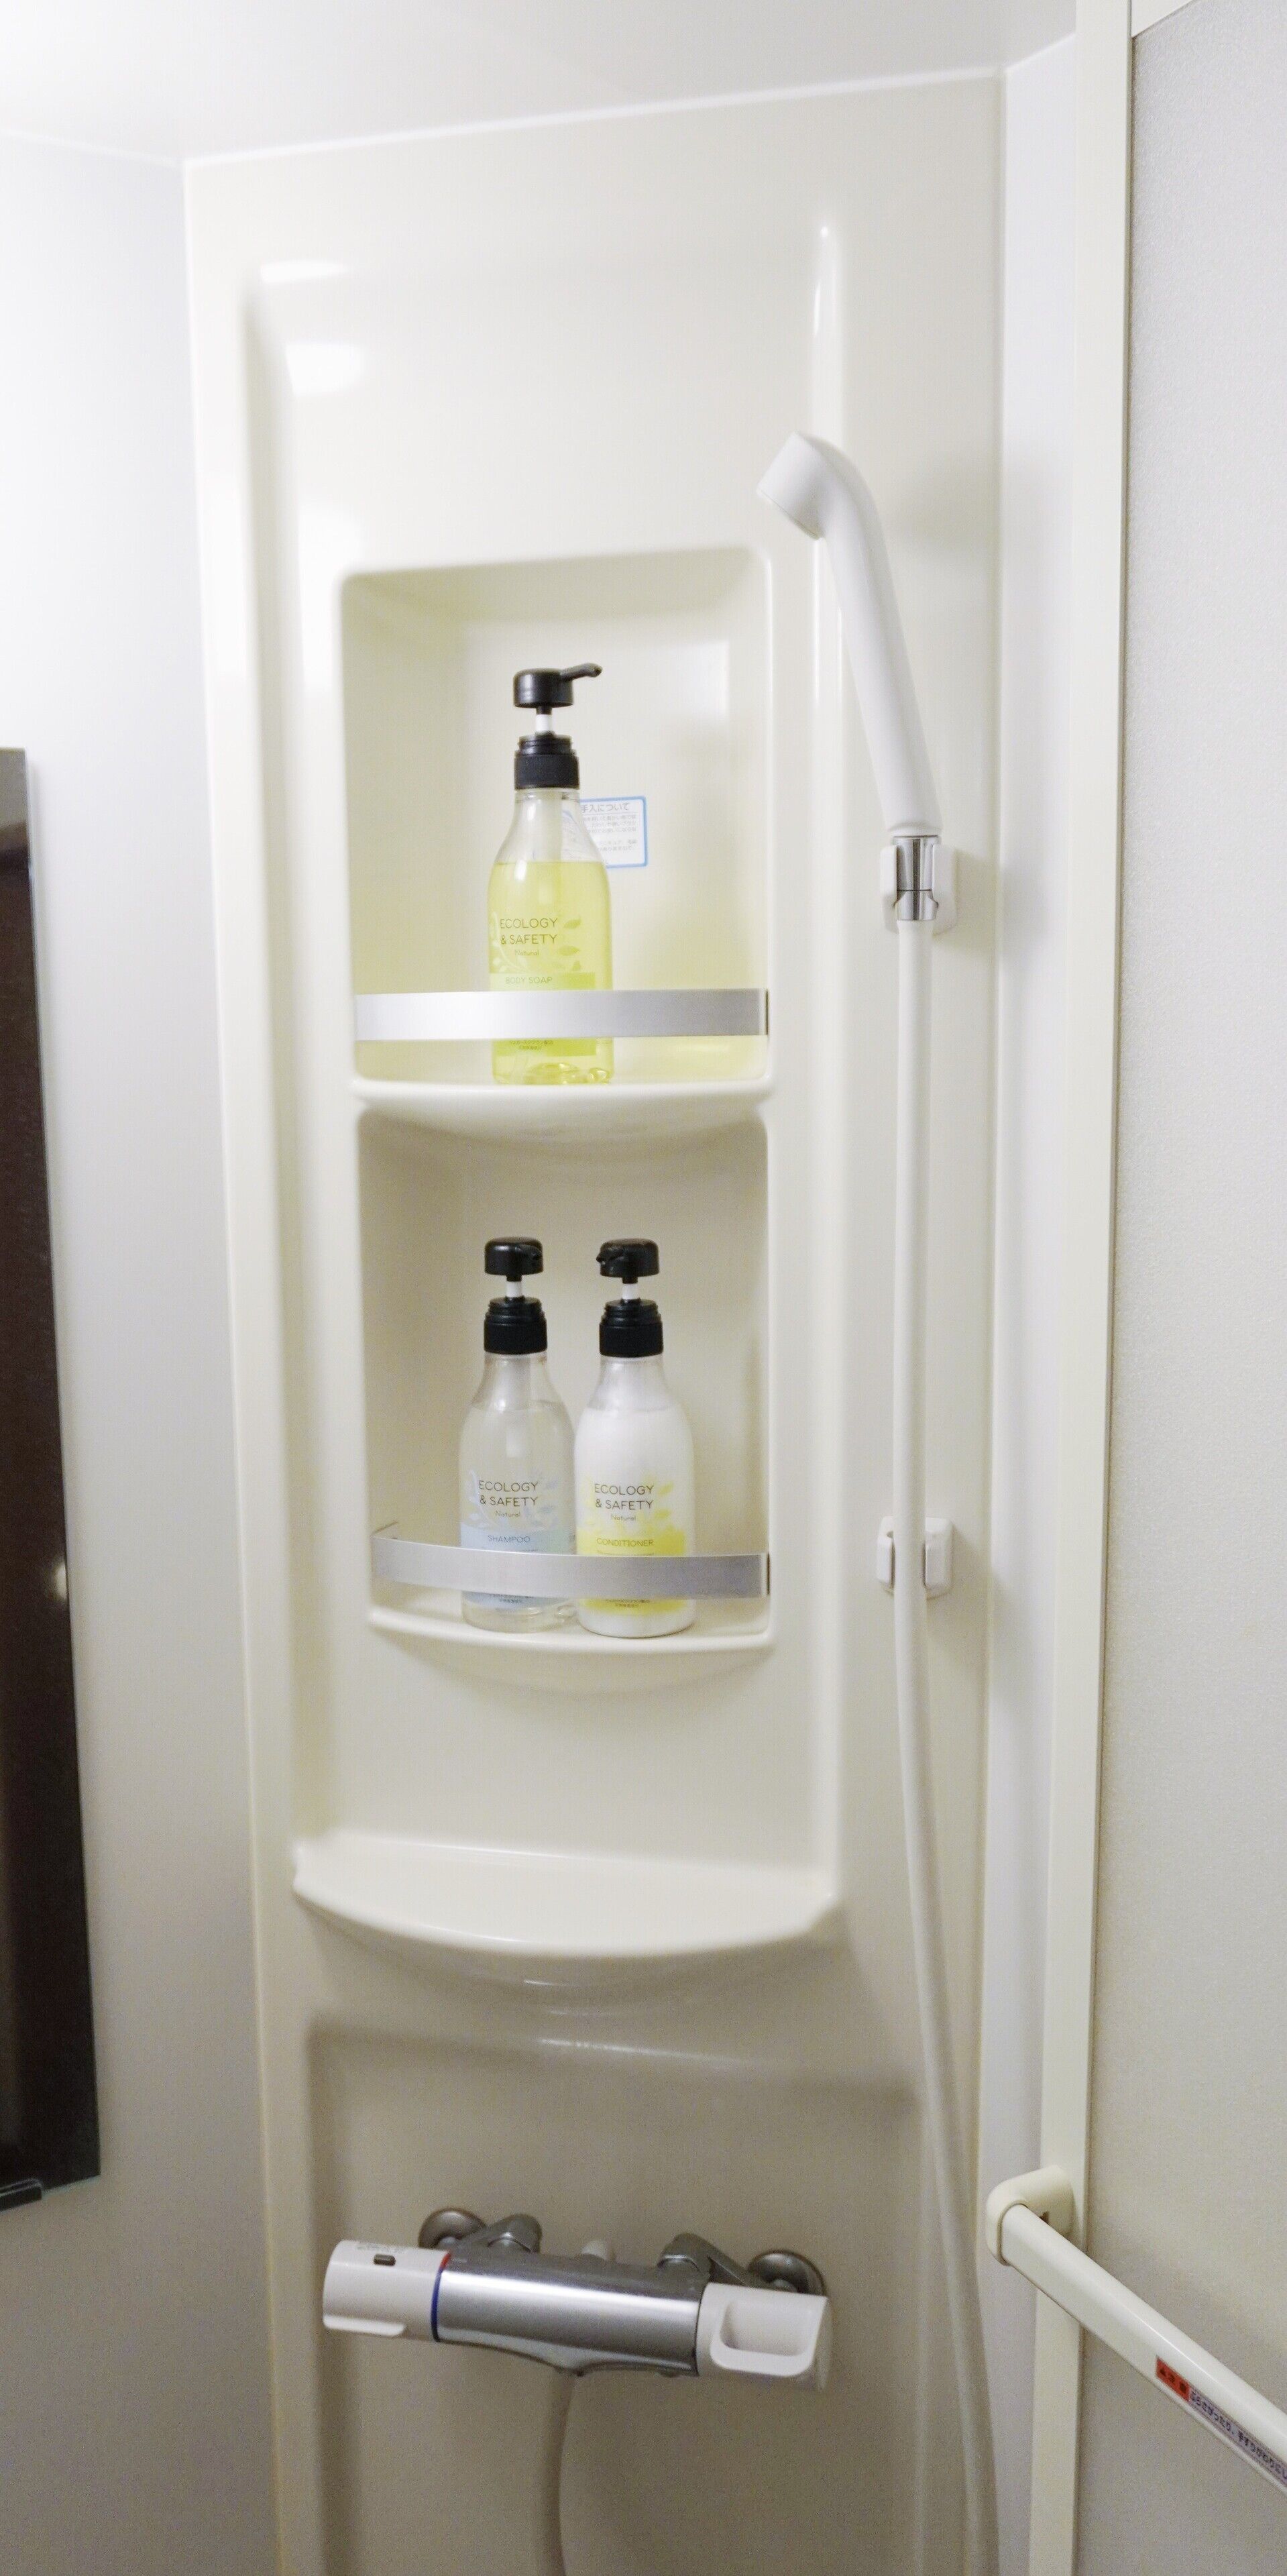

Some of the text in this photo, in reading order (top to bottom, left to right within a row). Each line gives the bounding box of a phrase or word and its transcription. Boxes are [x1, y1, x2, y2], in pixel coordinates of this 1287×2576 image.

[500, 918, 558, 929] ECOLOGY
[500, 934, 558, 945] & SAFETY
[506, 976, 553, 985] BODY SOAP
[479, 1480, 539, 1493] ECOLOGY
[594, 1483, 655, 1495] ECOLOGY
[480, 1495, 539, 1507] & SAFETY
[595, 1499, 654, 1510] & SAFETY
[495, 1510, 521, 1518] Natural
[488, 1536, 531, 1544] SHAMPOO
[596, 1538, 655, 1547] CONDITIONER
